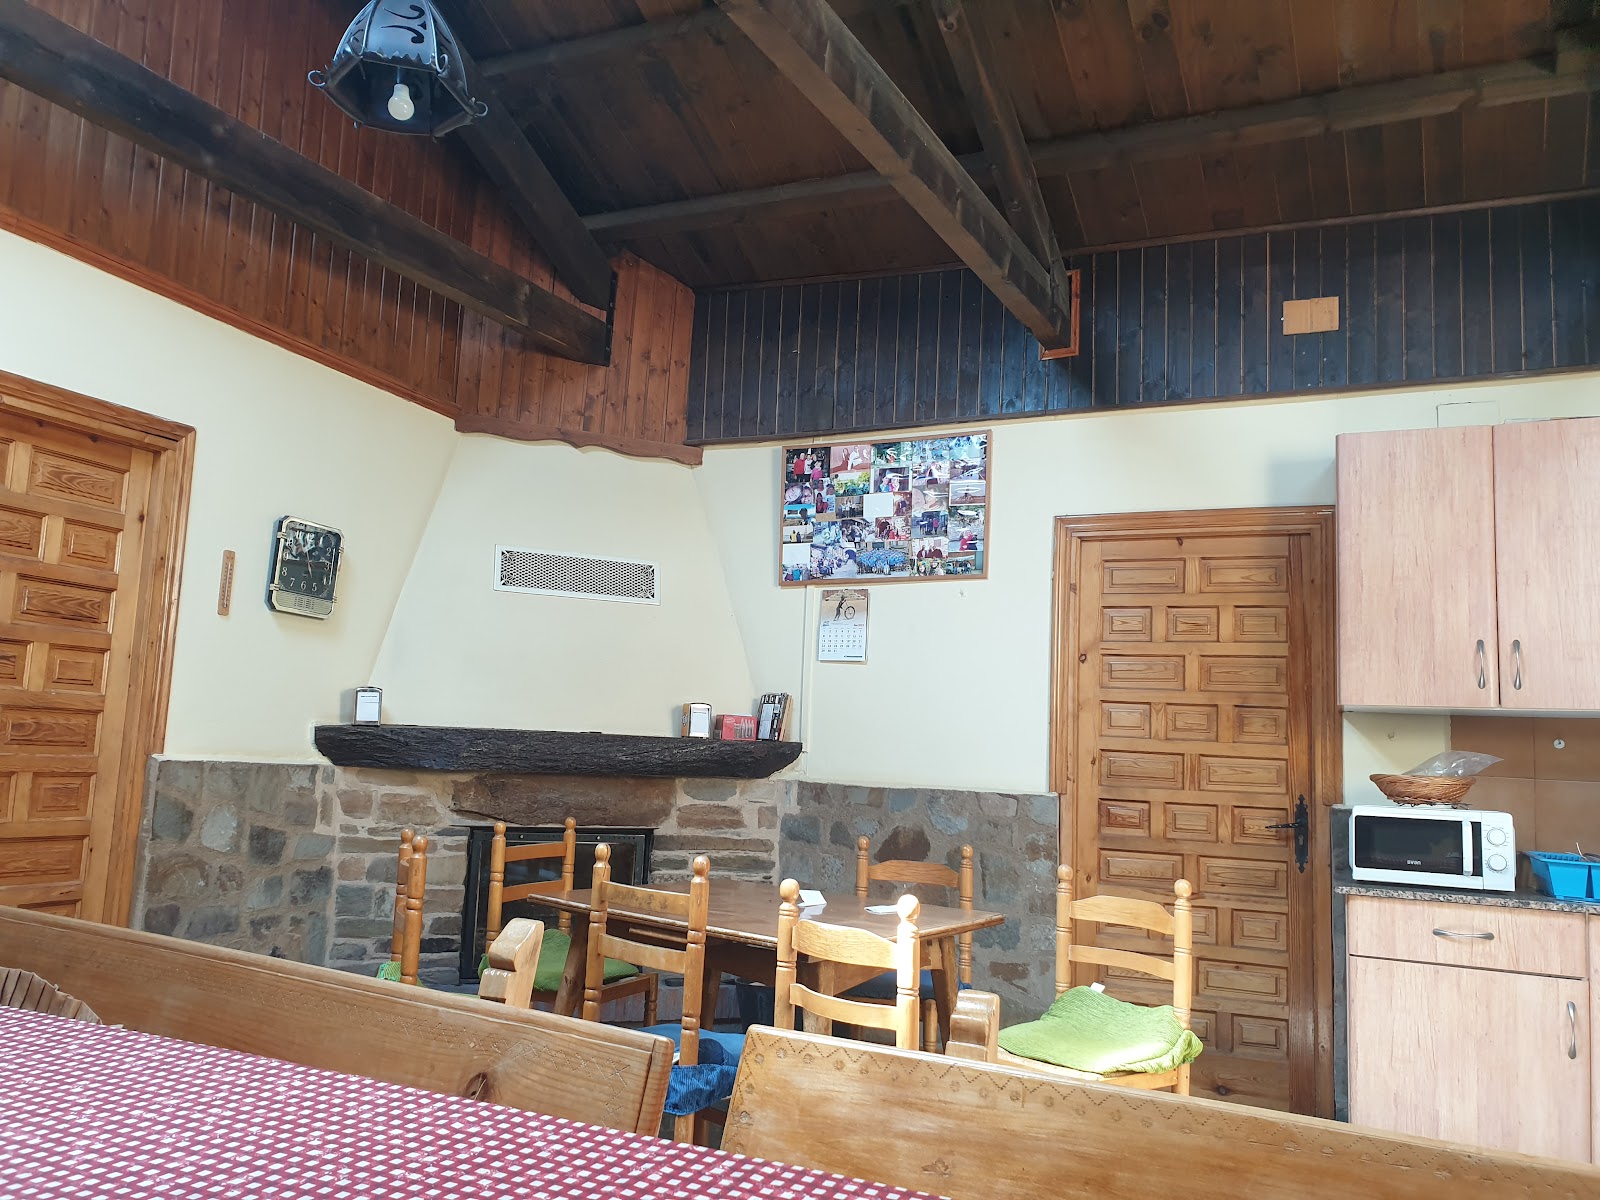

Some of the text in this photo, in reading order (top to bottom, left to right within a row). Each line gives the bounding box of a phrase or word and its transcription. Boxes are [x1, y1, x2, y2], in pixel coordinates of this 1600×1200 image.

[281, 567, 287, 576] 8
[289, 578, 295, 586] 7
[300, 581, 307, 590] 6
[311, 582, 317, 591] 5
